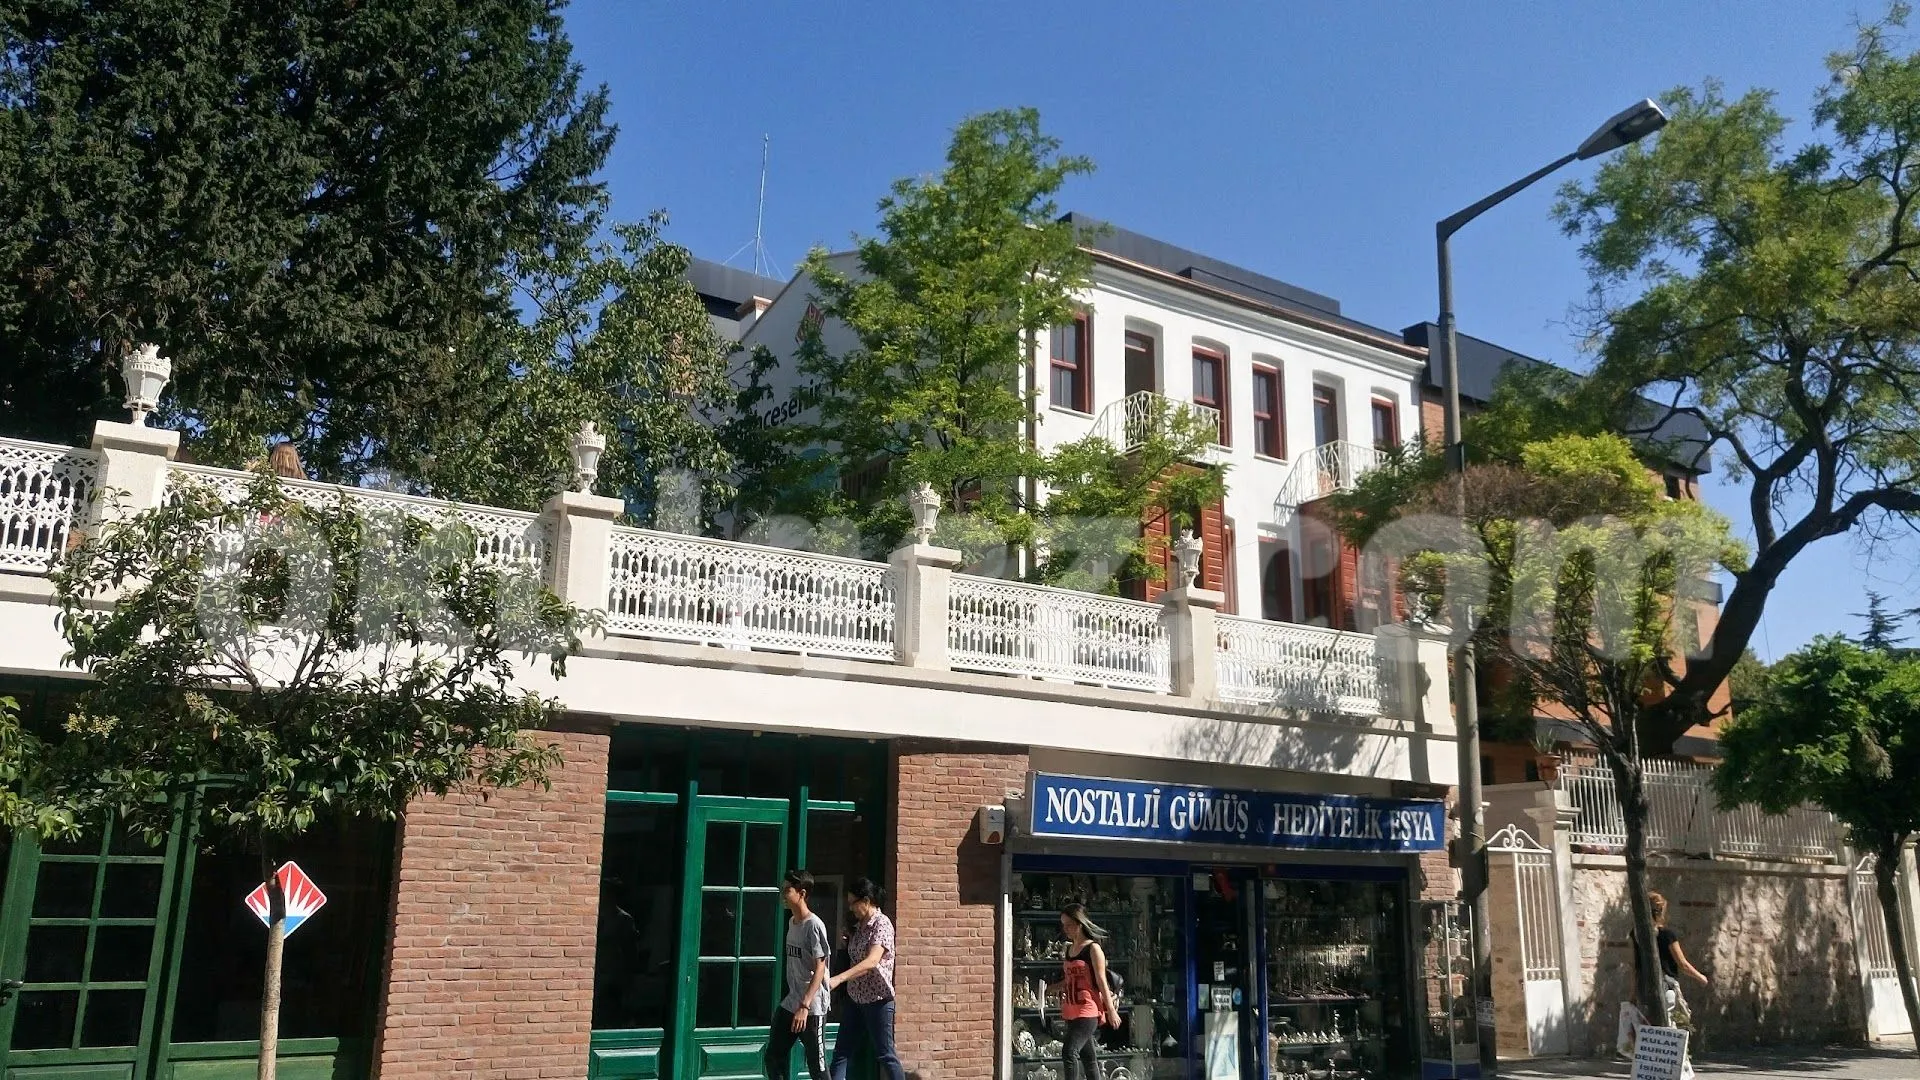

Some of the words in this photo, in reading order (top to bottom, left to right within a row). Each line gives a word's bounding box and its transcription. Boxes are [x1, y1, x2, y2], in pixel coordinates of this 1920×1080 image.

[1045, 787, 1161, 828] NOSTALJİ
[1169, 791, 1248, 840] GÜMÜŞ
[1272, 800, 1383, 840] HEDİYELİK
[1389, 810, 1436, 847] EŞYA
[1641, 1036, 1678, 1047] KULAK
[1640, 1045, 1678, 1056] BURUN
